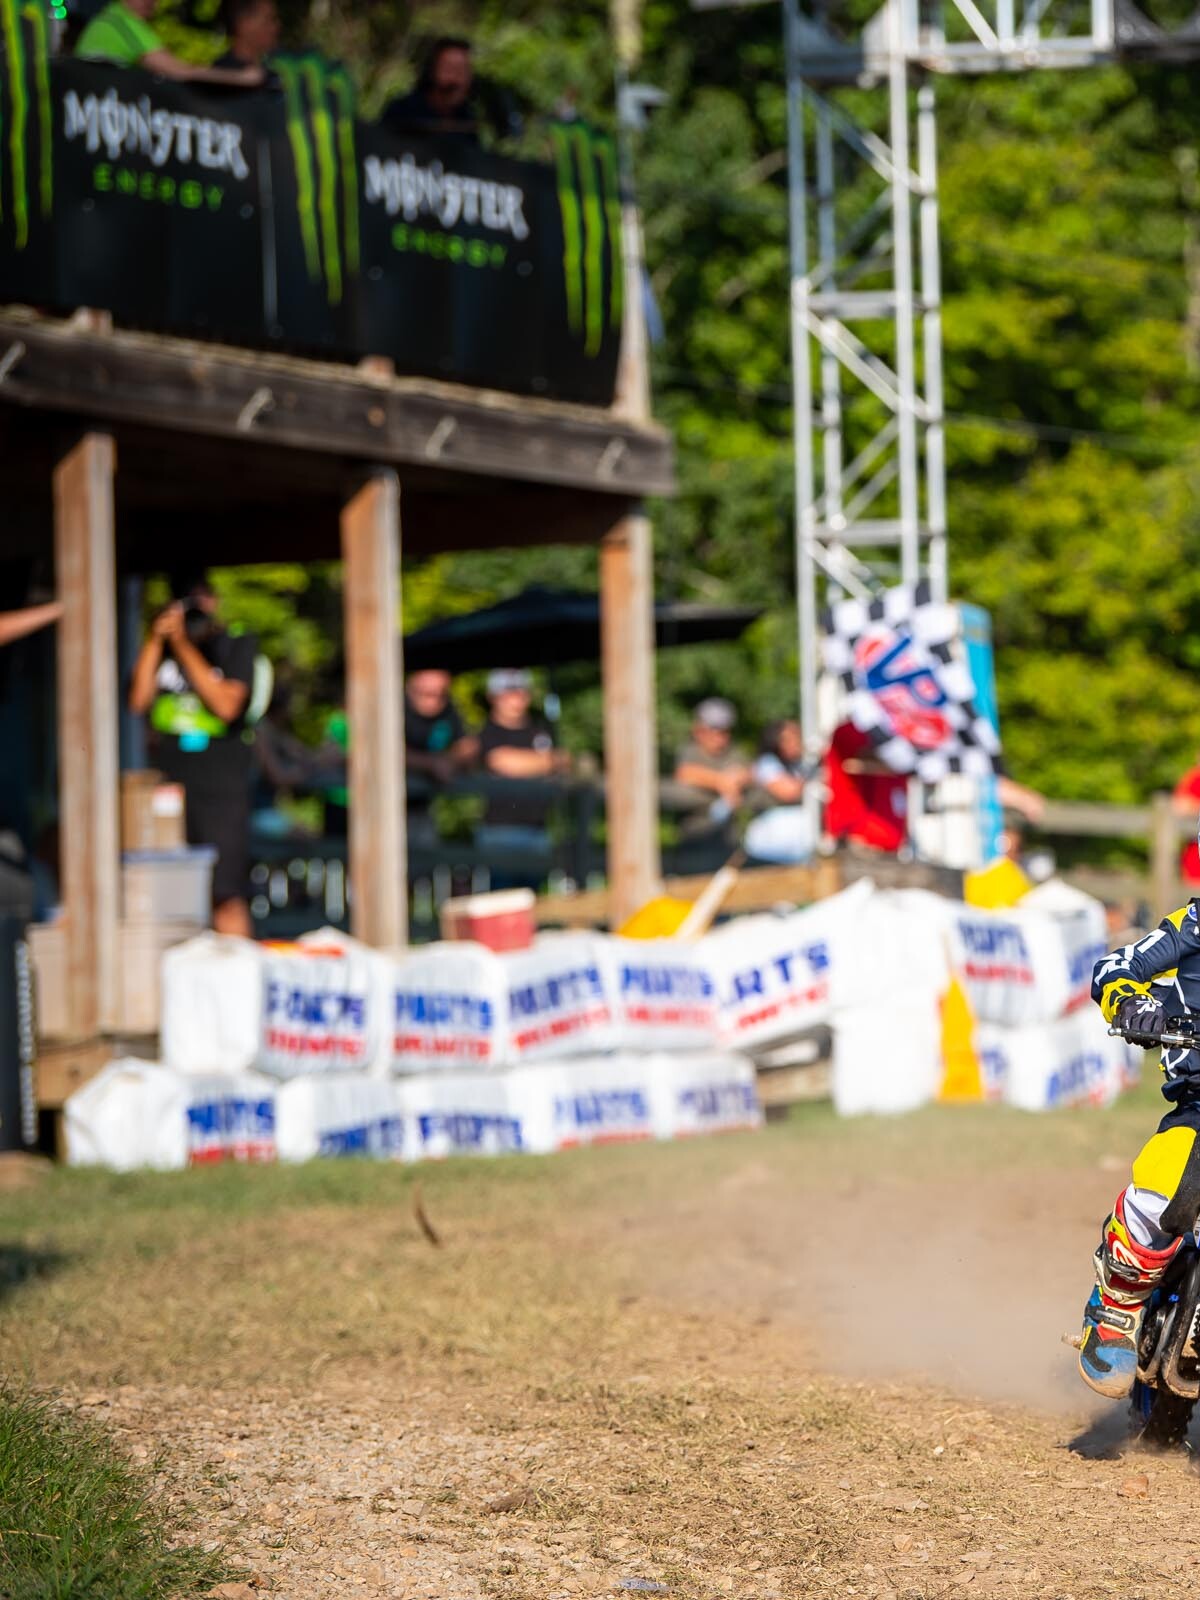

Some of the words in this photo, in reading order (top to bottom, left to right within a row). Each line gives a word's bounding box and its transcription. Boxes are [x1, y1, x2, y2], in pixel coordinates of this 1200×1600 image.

[63, 86, 250, 181] MONSTER
[93, 162, 226, 213] ENERGY
[363, 151, 531, 242] MONSTER
[392, 221, 509, 269] ENERGY
[730, 942, 829, 1002] ARTS
